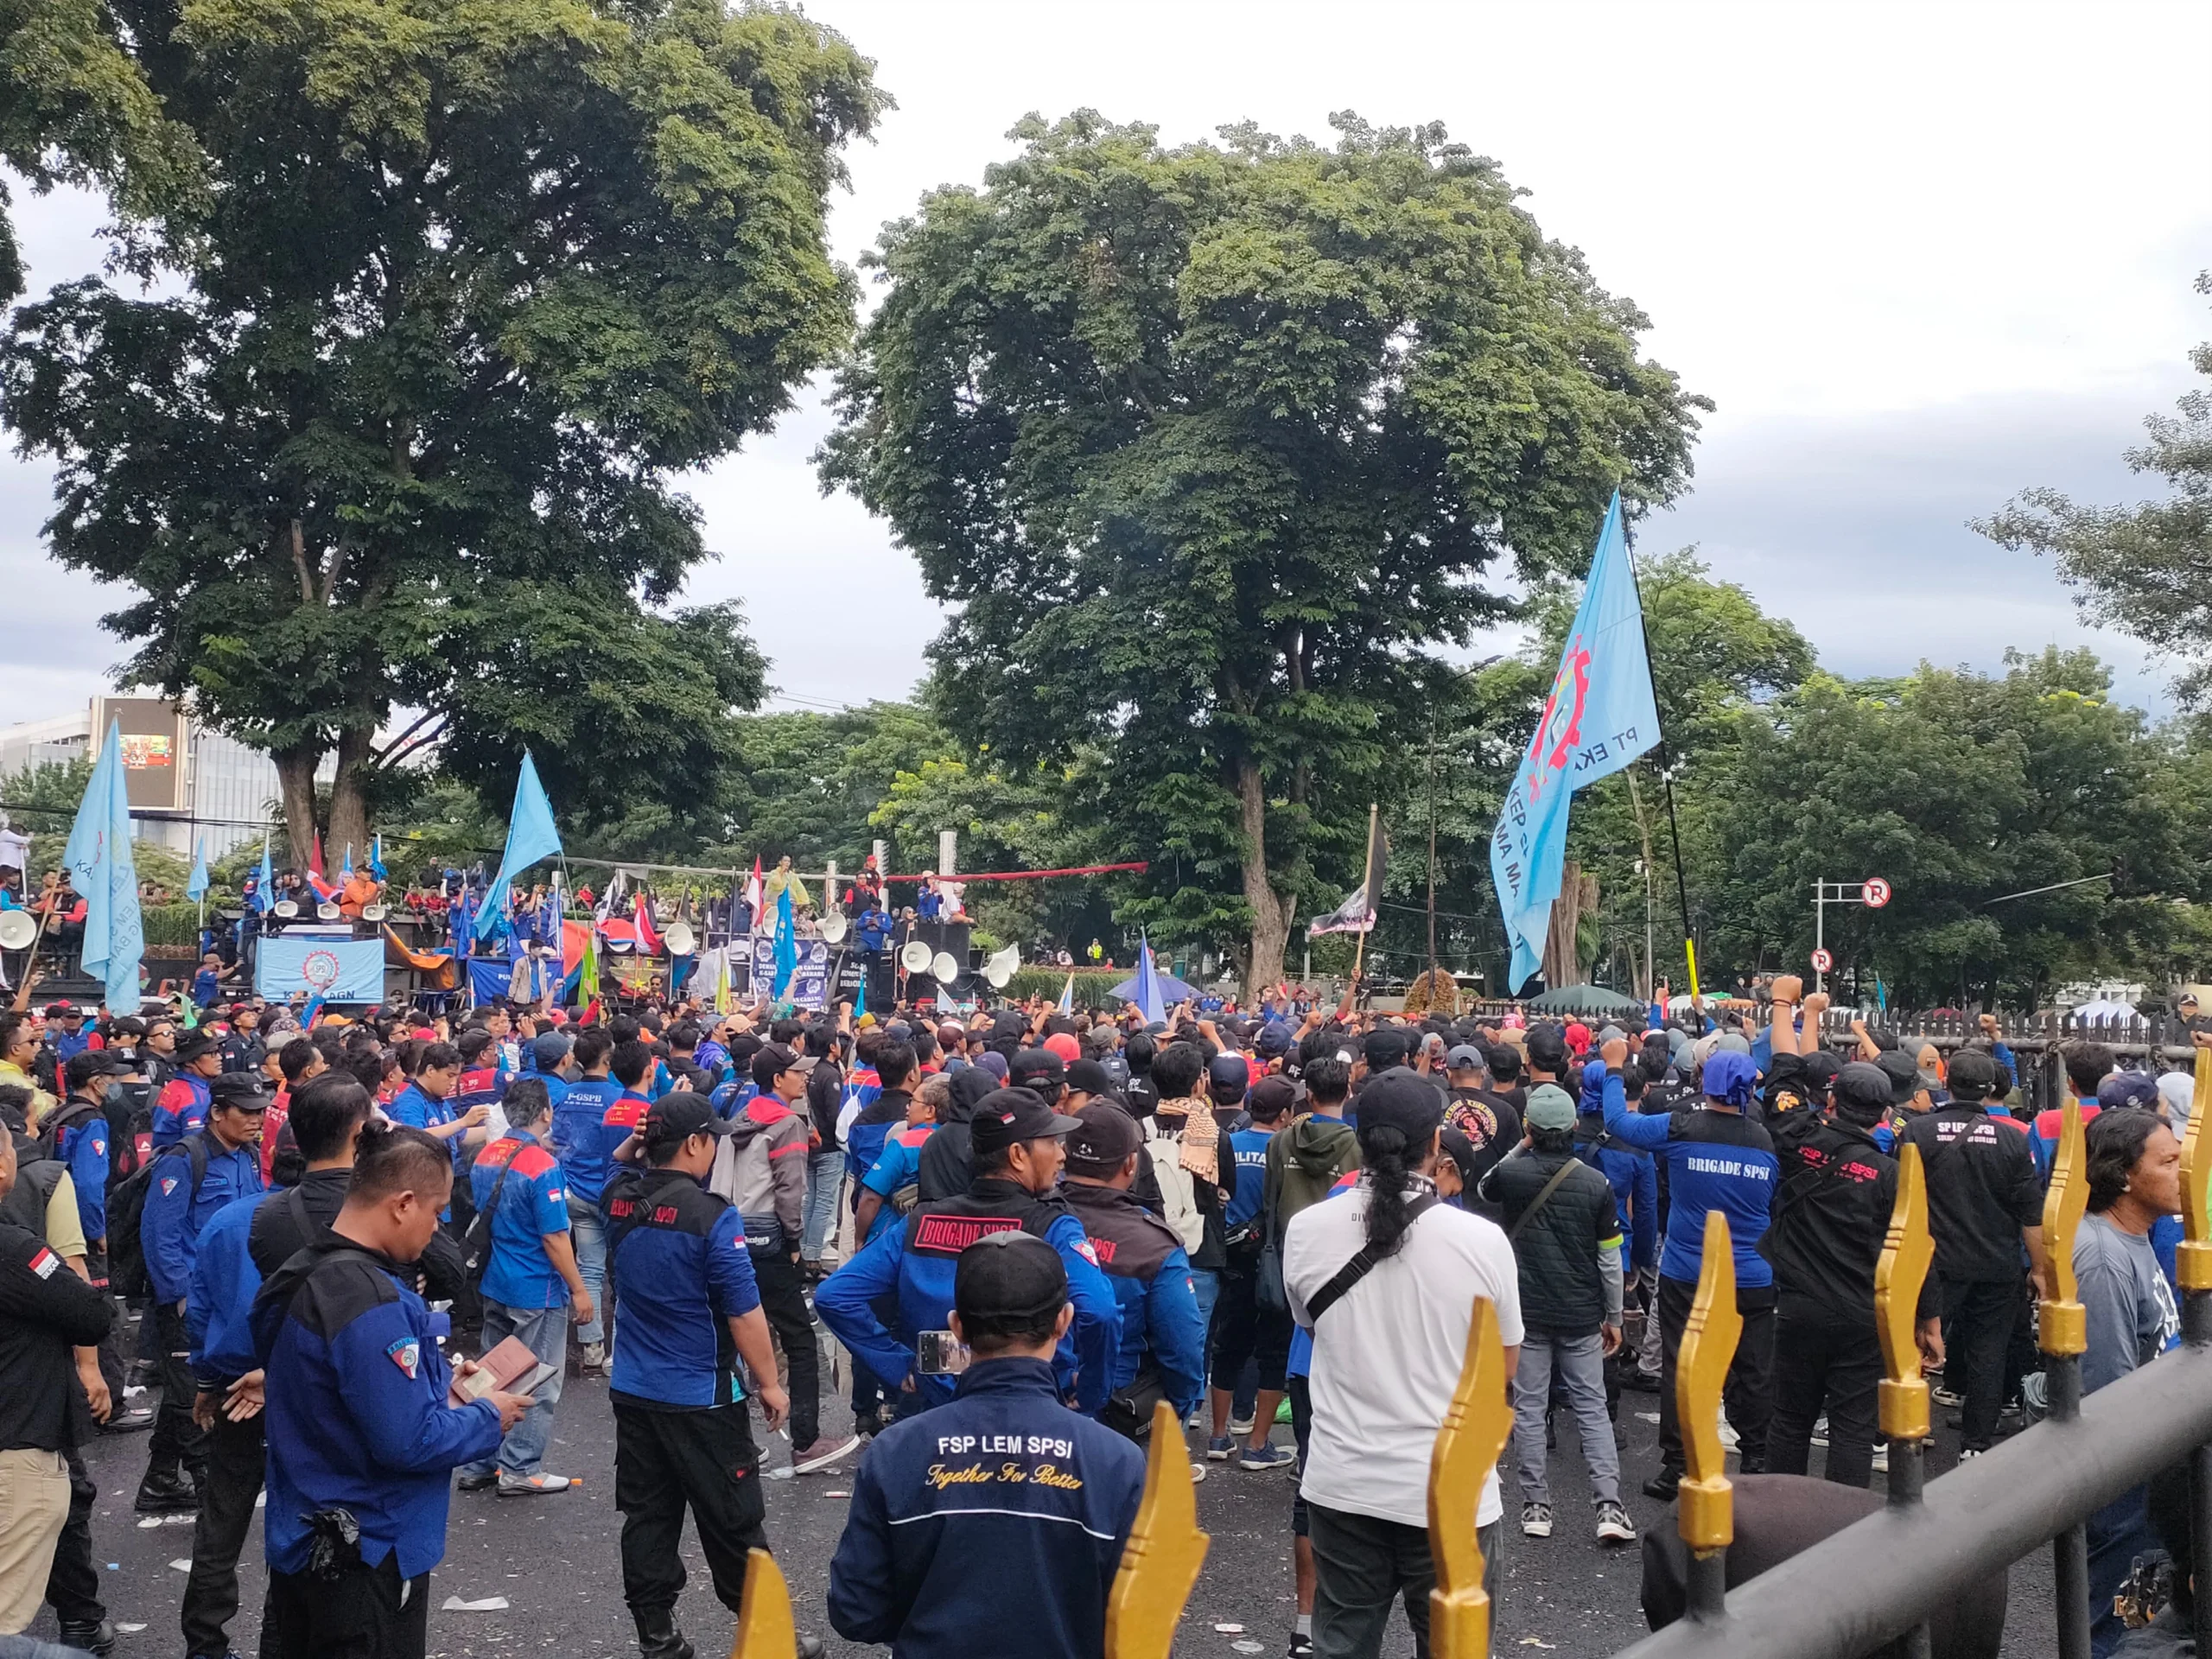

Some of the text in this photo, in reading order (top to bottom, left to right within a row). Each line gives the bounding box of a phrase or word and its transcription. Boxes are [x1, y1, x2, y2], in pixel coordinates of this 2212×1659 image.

[1937, 1122, 1951, 1133] SP
[1688, 1157, 1770, 1181] BRIGADE SPSI
[938, 1435, 1073, 1459] FSP LEM SPSI
[925, 1462, 1083, 1491] Together For Better
